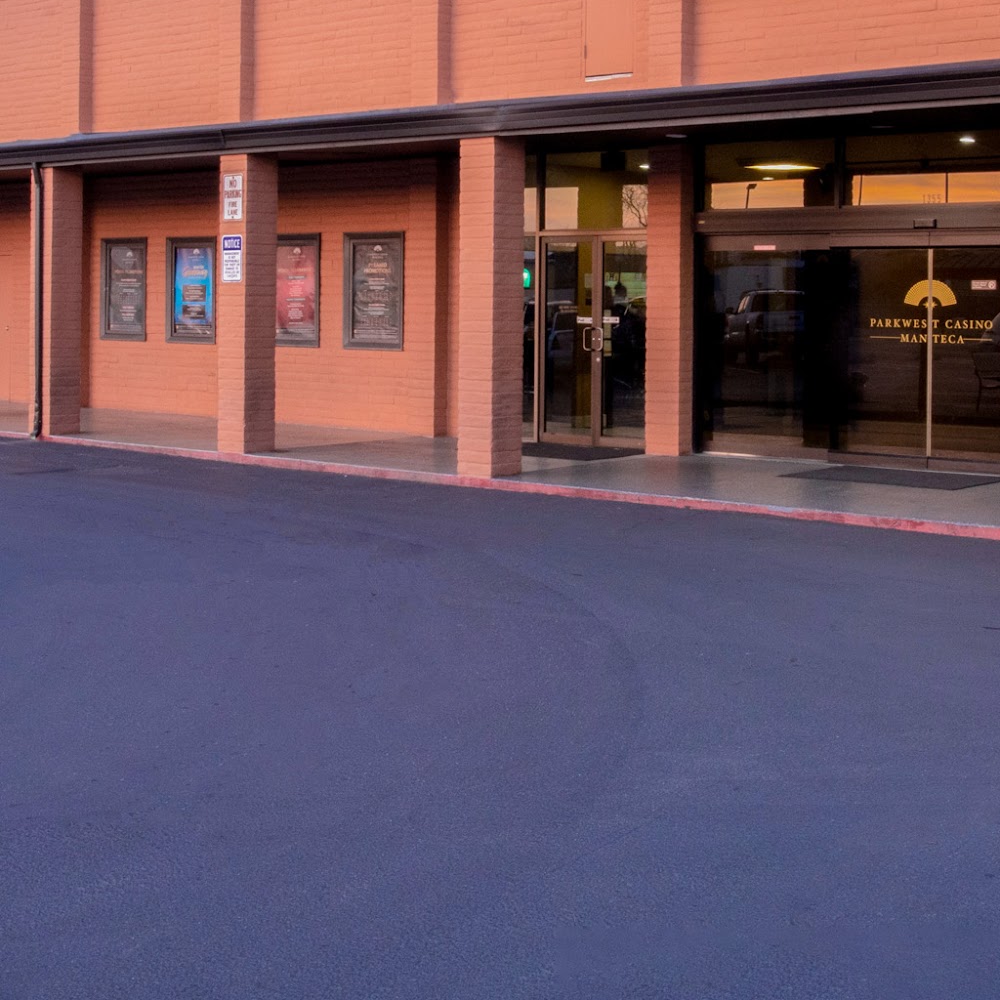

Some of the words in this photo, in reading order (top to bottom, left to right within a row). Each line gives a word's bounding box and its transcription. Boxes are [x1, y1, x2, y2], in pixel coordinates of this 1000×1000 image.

[228, 179, 238, 188] NO
[223, 190, 242, 199] PARKING
[223, 238, 241, 249] NOTICE
[870, 317, 940, 330] PARKWEST
[944, 319, 994, 330] CASINO
[899, 333, 965, 345] MANTECA
